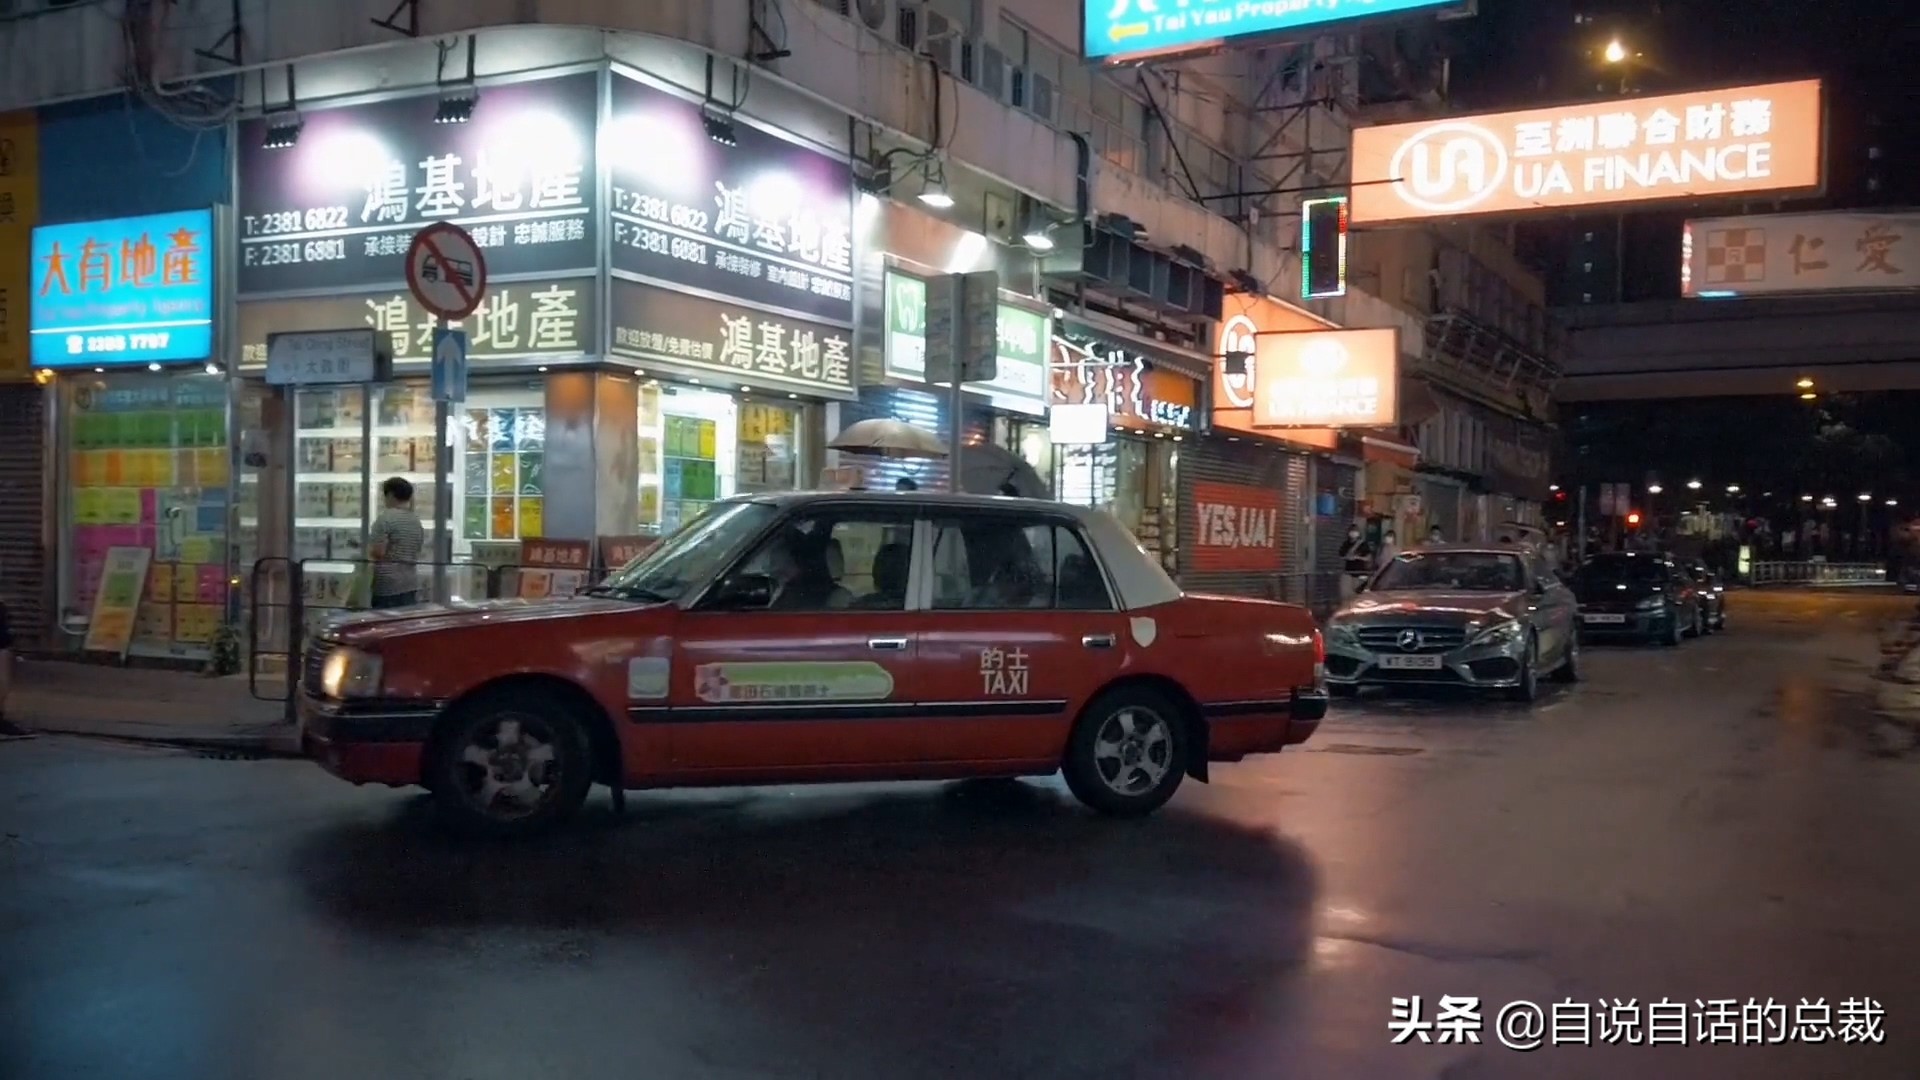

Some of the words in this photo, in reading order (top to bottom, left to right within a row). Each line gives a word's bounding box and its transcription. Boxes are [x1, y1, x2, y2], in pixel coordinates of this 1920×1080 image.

[1153, 13, 1186, 32] Tai
[1191, 8, 1232, 26] Yau
[1514, 99, 1772, 158] 亞洲聯合財務
[1513, 160, 1573, 199] UA
[1584, 141, 1771, 193] FINANCE
[244, 215, 260, 236] T:
[262, 210, 302, 235] 2381
[304, 206, 349, 231] 6822
[613, 187, 628, 208] T:
[631, 192, 668, 222] 2381
[671, 204, 708, 233] 6822
[244, 247, 259, 267] F:
[261, 242, 302, 266] 2381
[613, 222, 628, 245] F:
[631, 227, 668, 254] 2381
[1787, 222, 1903, 275] 仁愛
[38, 227, 202, 296] 大有地產
[719, 313, 850, 385] 鴻基地產
[980, 647, 1029, 669] 的士
[980, 669, 1028, 695] TAXI
